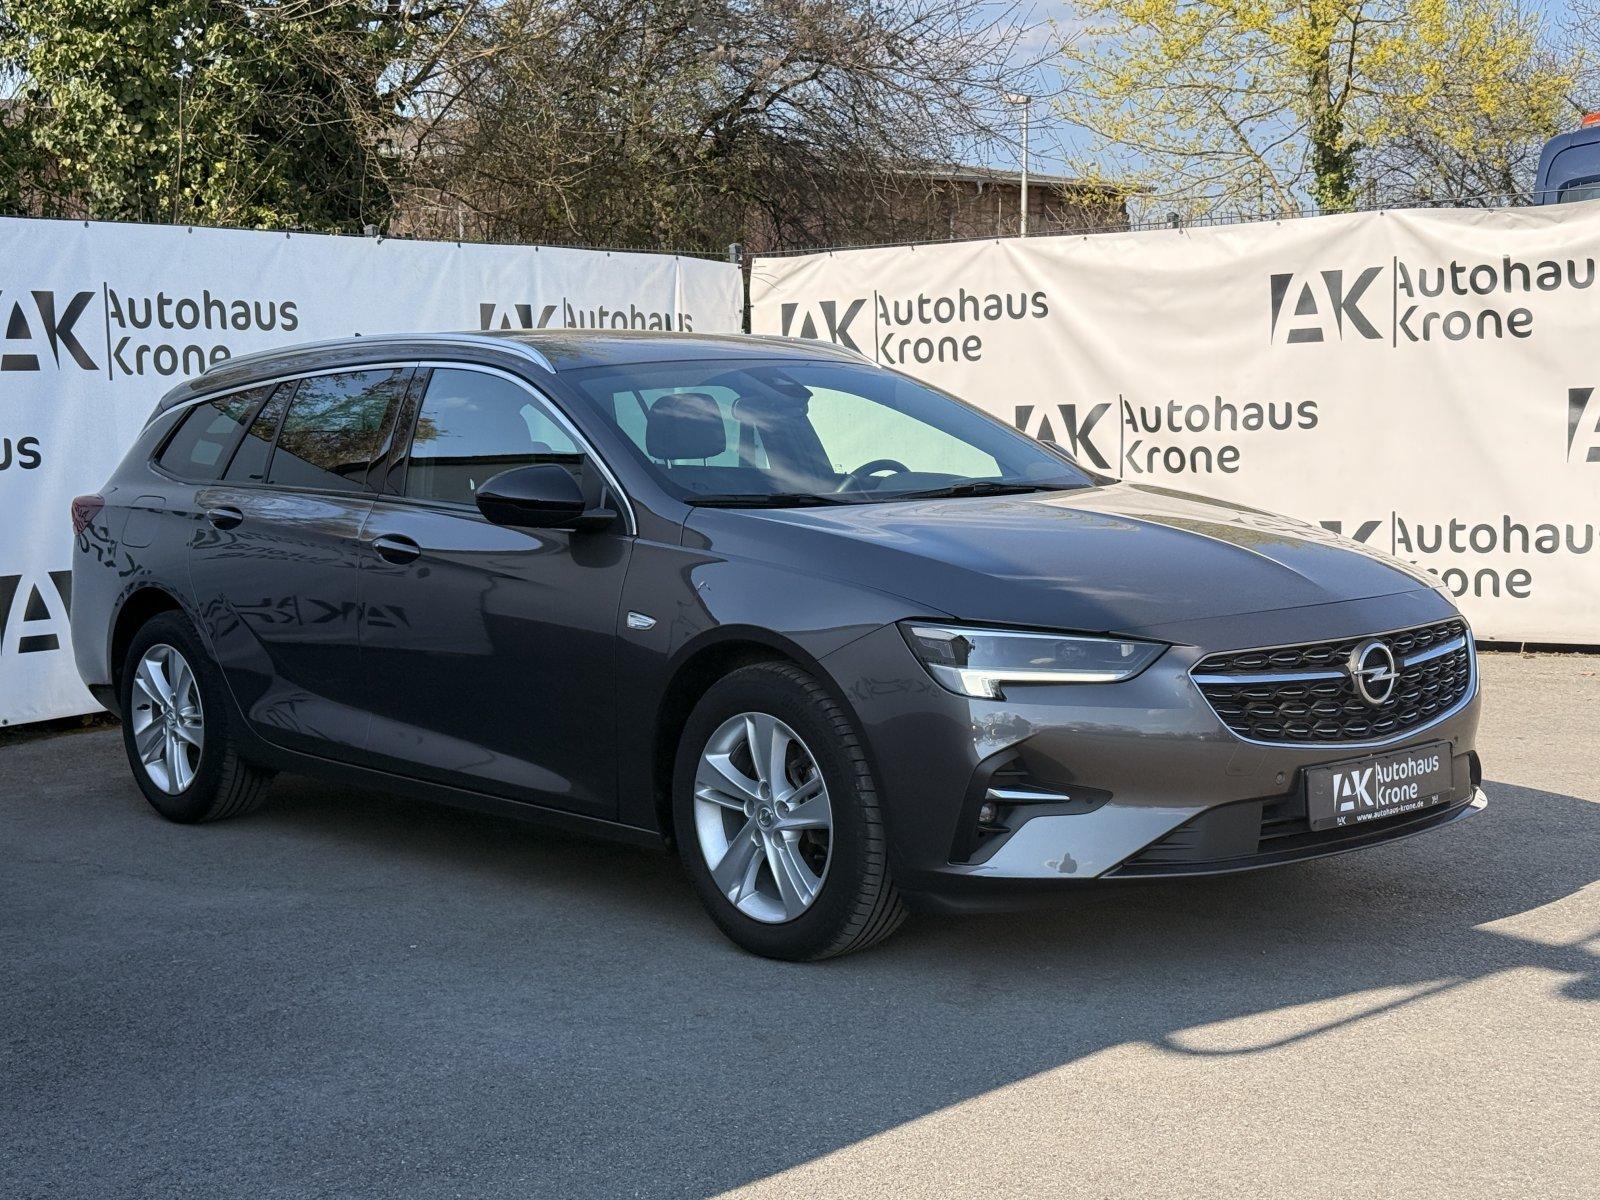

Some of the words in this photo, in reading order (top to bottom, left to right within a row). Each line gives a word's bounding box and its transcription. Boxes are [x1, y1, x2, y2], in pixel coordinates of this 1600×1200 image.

[1398, 254, 1595, 298] Autohau
[108, 288, 299, 331] Autohaus
[879, 288, 1049, 326] Autohaus
[1270, 266, 1384, 345] AK
[1399, 304, 1533, 342] Krone
[880, 332, 982, 365] Krone
[1124, 395, 1318, 433] Autohaus
[1125, 439, 1241, 474] Krone
[1397, 514, 1600, 554] Autohau
[1377, 755, 1439, 784] Autohaus
[1333, 767, 1375, 813] AK
[1378, 782, 1418, 806] Krone
[1356, 800, 1424, 822] www.autohaus-krone.de
